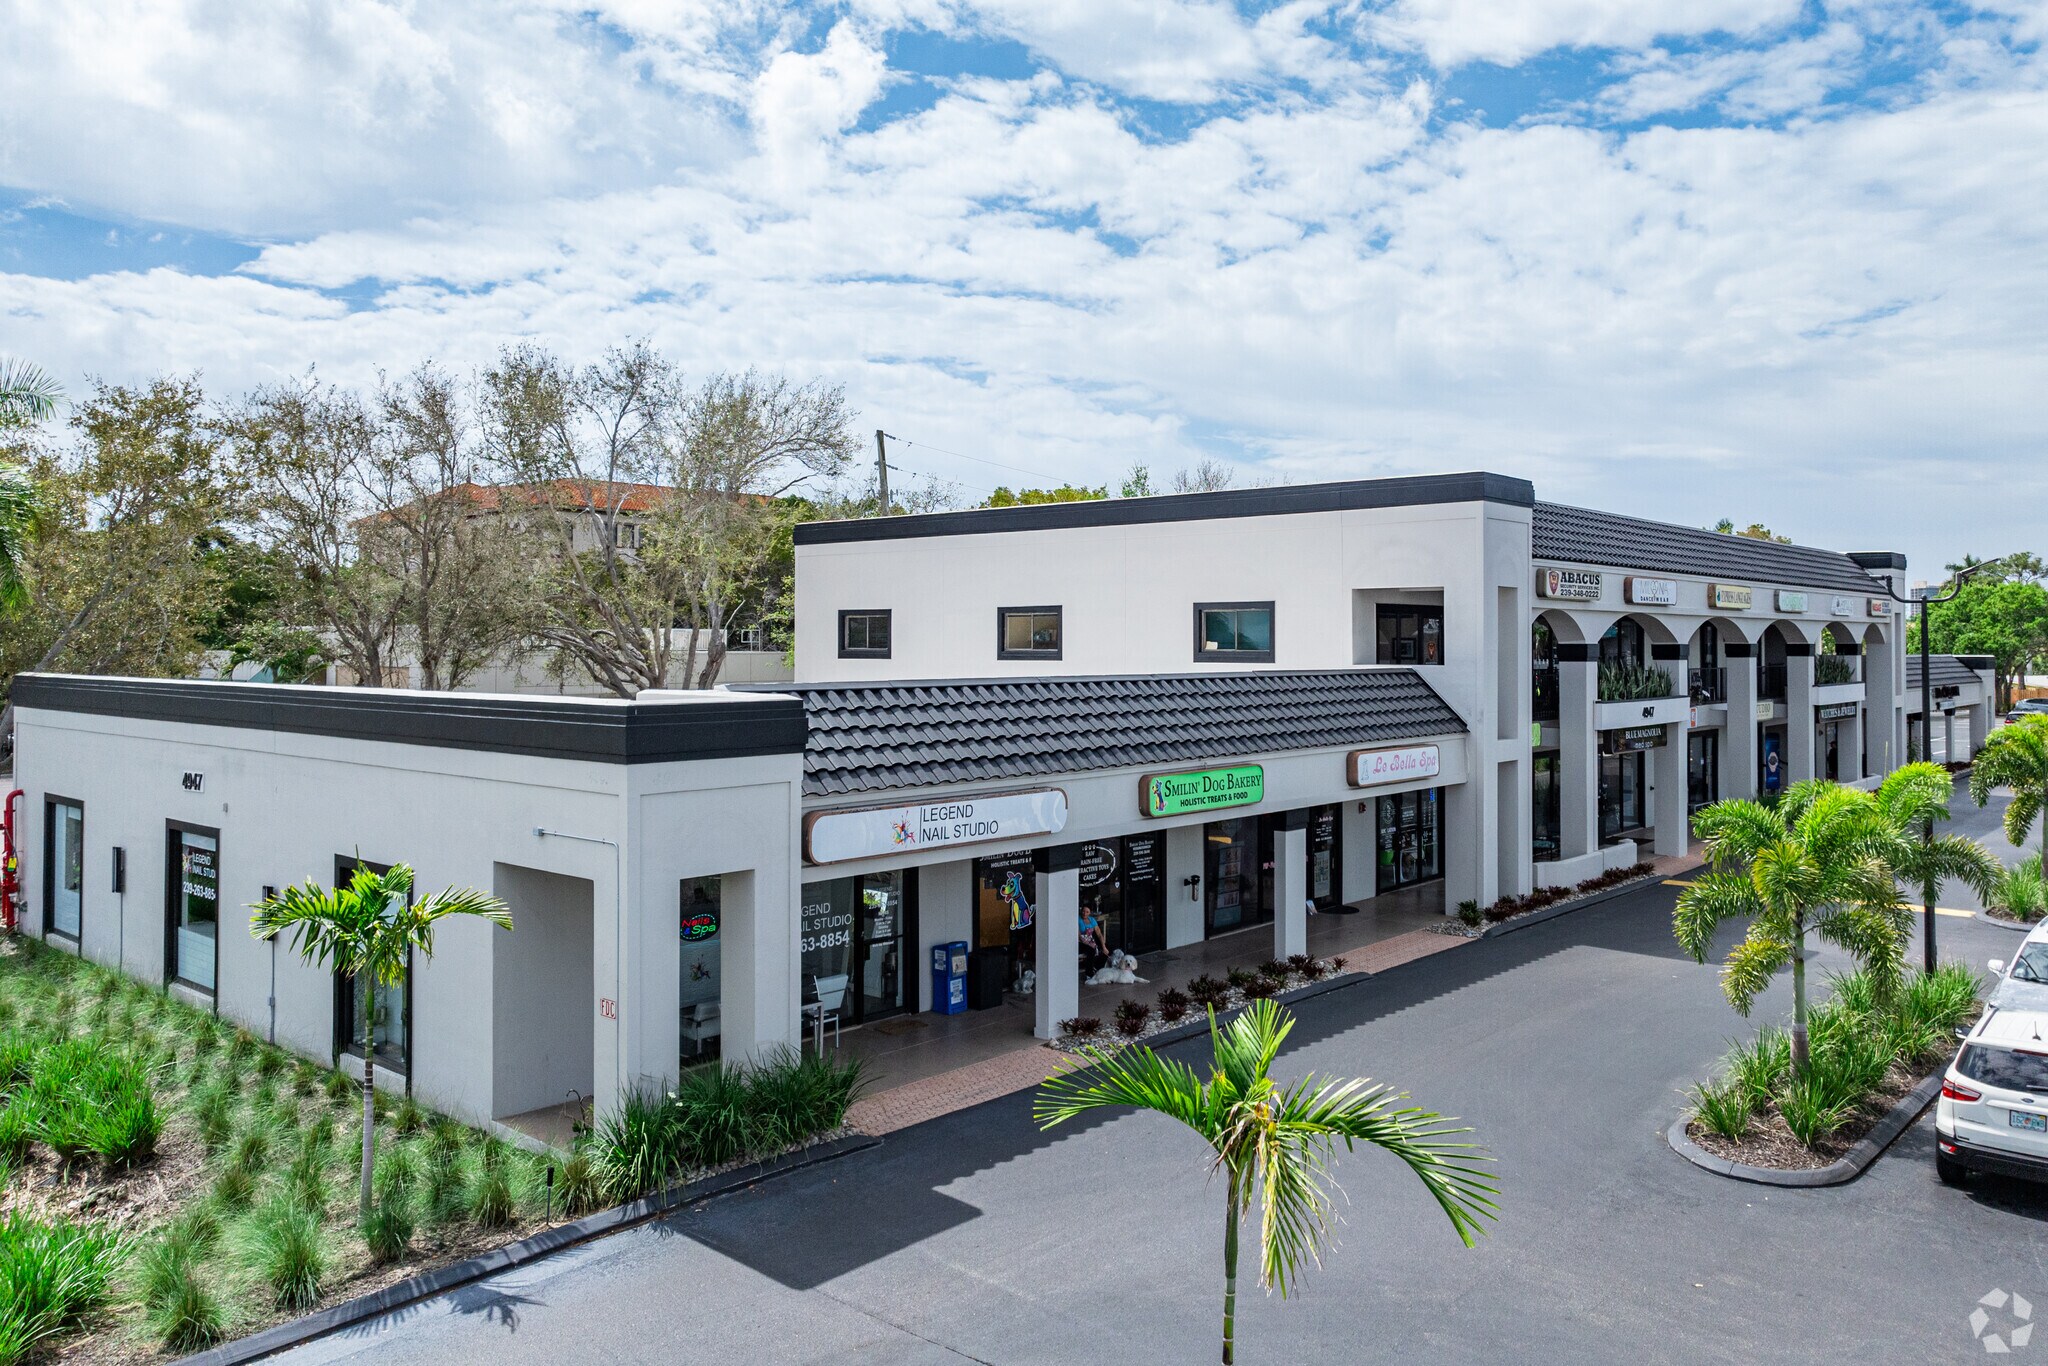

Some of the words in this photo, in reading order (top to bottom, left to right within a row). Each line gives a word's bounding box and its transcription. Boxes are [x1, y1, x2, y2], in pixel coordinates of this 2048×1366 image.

[1560, 572, 1600, 585] ABACUS
[1560, 589, 1599, 598] 239-348-0222
[1642, 706, 1655, 718] 4947
[1625, 730, 1637, 740] BLUE
[1637, 727, 1661, 738] MAGNOLIA
[1390, 754, 1416, 771] Bella
[1420, 751, 1436, 772] Spa
[182, 772, 203, 791] 4947
[1203, 776, 1225, 793] DOG
[1227, 773, 1262, 790] BAKERY
[1180, 797, 1207, 808] HOLISTIC
[1207, 794, 1228, 804] TREATS
[1233, 791, 1249, 801] FOOD
[923, 804, 974, 823] LEGEND
[922, 825, 951, 842] NAIL
[953, 820, 999, 839] STUDIO
[192, 853, 211, 866] LEGEND
[1080, 857, 1103, 866] RAIN-FREE
[1080, 865, 1098, 873] RACTIVE
[800, 902, 831, 917] GEND
[681, 917, 710, 928] Nails
[813, 913, 852, 930] STUDIO
[691, 924, 717, 936] Spa
[800, 929, 850, 953] 63-8854
[601, 999, 615, 1018] FDC
